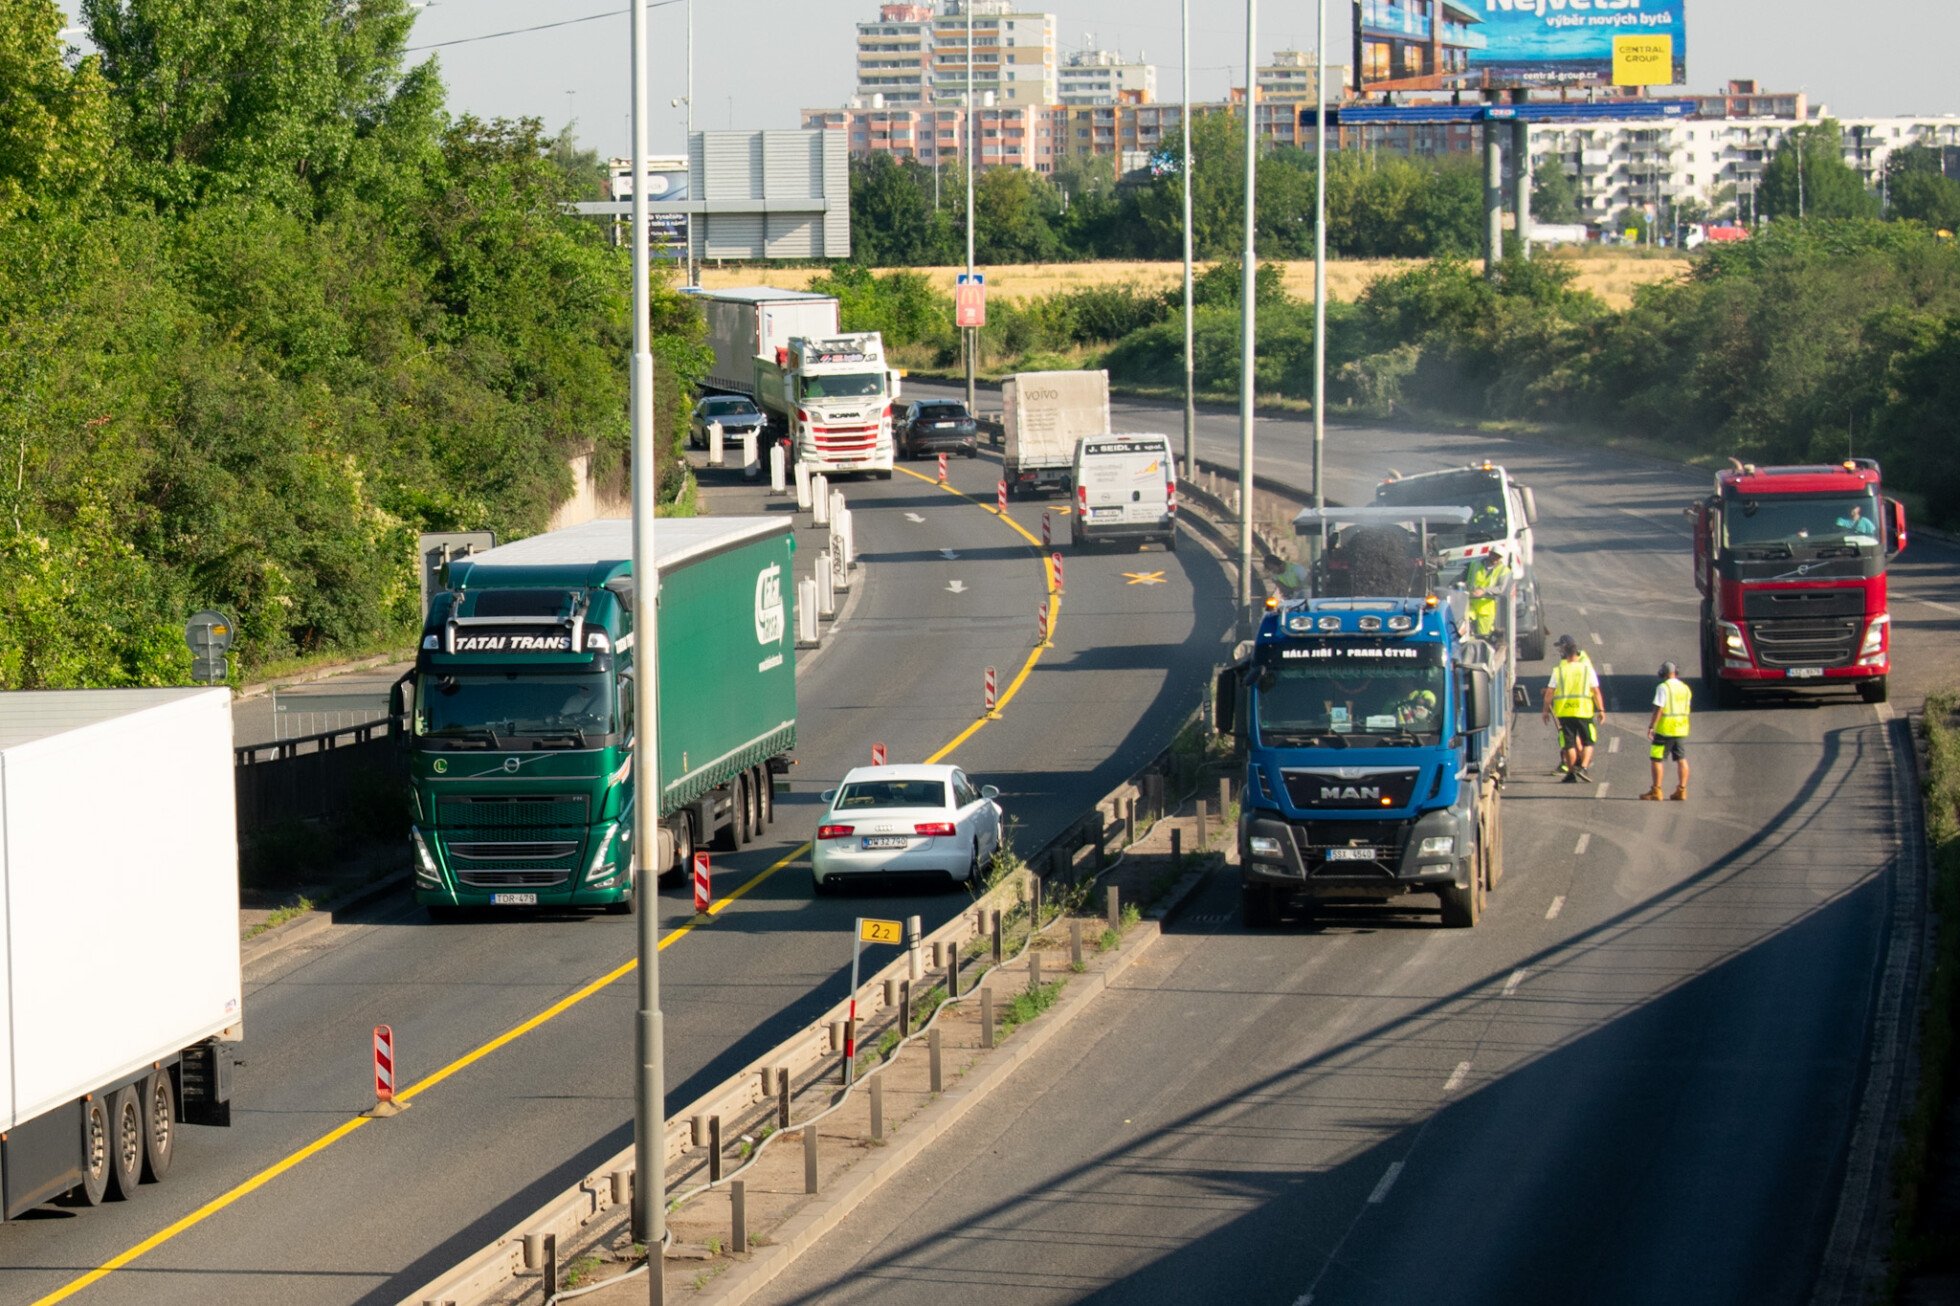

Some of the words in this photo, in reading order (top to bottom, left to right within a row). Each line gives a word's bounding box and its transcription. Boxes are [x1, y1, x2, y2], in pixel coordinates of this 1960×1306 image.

[1546, 13, 1585, 28] výběr
[1588, 12, 1637, 27] nových
[1640, 11, 1672, 26] bytů
[1619, 46, 1665, 54] CENTRAL
[1625, 54, 1659, 63] GROUP
[1523, 70, 1598, 81] central-group.cz
[829, 411, 860, 419] SCANIA
[1100, 444, 1131, 452] SEIDL
[456, 636, 506, 650] TATAI
[510, 635, 571, 650] TRANS
[1347, 648, 1383, 658] PRAHA
[1321, 786, 1379, 799] MAN
